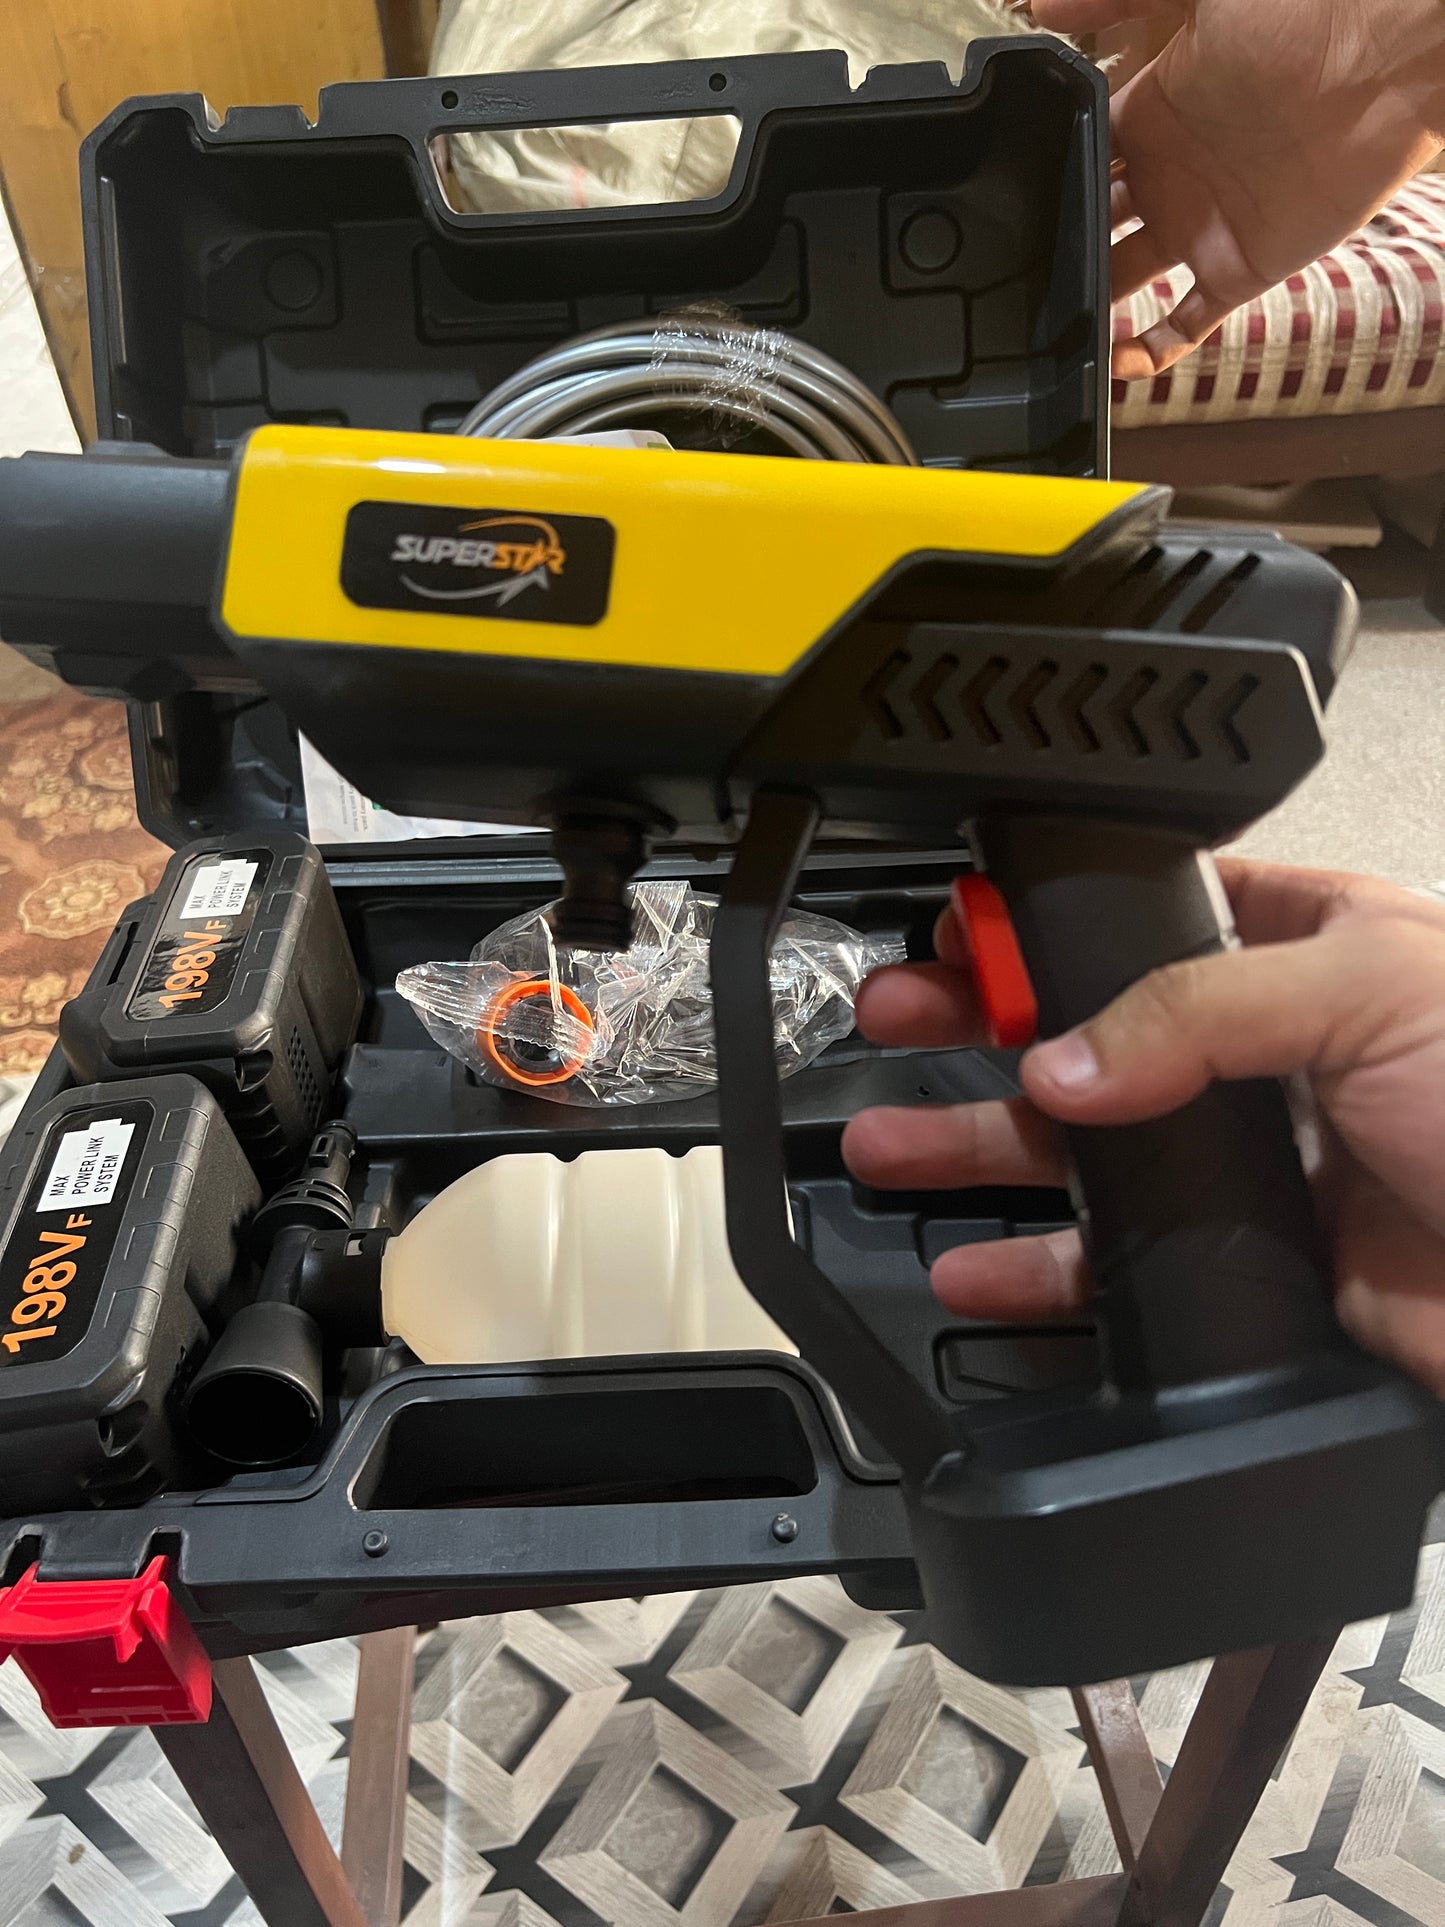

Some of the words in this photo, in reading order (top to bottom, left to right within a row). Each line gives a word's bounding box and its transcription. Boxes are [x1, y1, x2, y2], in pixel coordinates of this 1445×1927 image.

[391, 534, 566, 575] SUPERSTAR
[189, 895, 206, 909] MAX
[226, 882, 246, 907] SYSTEM
[49, 1175, 70, 1197] MAX
[94, 1154, 119, 1193] SYSTEM
